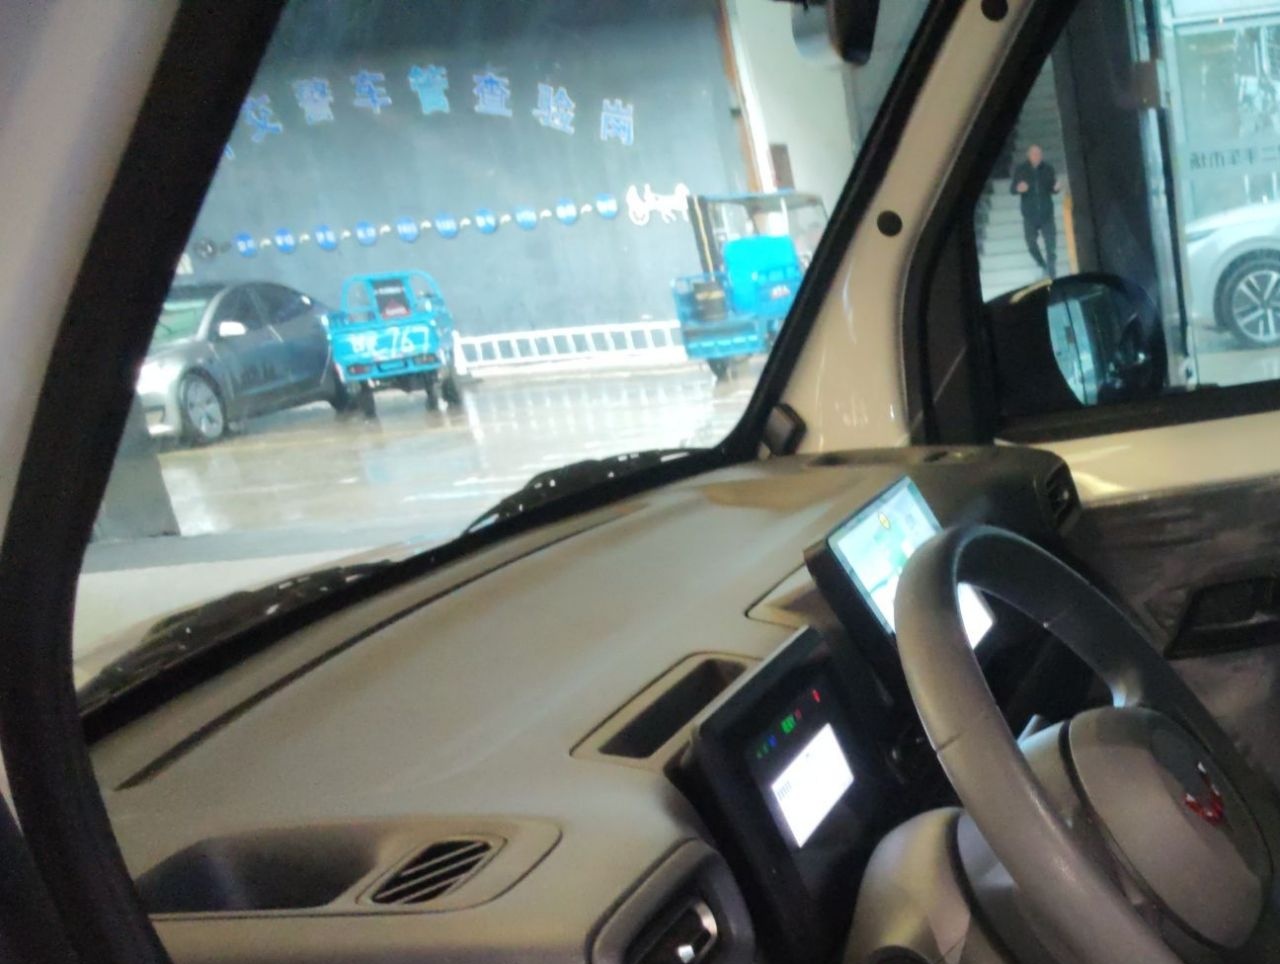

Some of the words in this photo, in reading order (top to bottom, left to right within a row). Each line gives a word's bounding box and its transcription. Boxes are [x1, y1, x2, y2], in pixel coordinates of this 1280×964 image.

[225, 64, 635, 161] 交警车管查验岗
